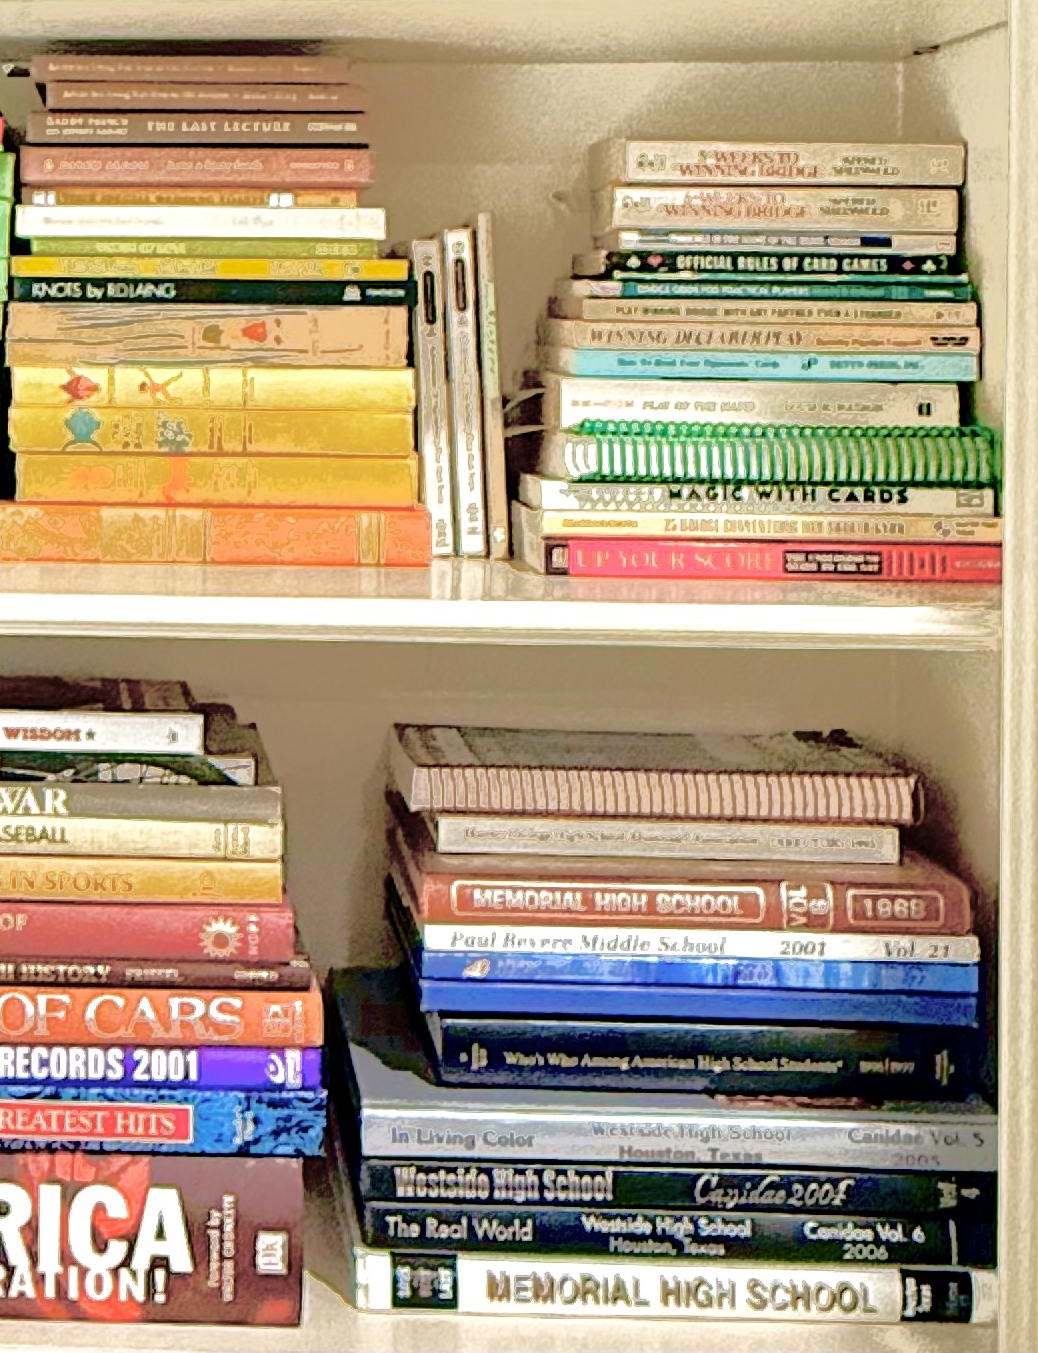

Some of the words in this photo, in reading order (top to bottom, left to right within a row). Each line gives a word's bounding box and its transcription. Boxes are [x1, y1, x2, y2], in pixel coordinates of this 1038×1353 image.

[829, 490, 908, 503] CARDS
[4, 727, 80, 742] WISDOM
[10, 872, 37, 889] IN
[45, 873, 133, 892] SPORTS
[474, 889, 585, 911] MEMORIAL
[595, 891, 647, 912] HIGH
[655, 893, 745, 914] SCHOOL
[659, 935, 726, 954] School
[85, 997, 243, 1040] CARS
[133, 1049, 198, 1081] 2001
[114, 1112, 174, 1136] HITS
[391, 1128, 412, 1144] In
[417, 1128, 475, 1149] Living
[483, 1130, 534, 1148] Color
[386, 1218, 419, 1238] The
[425, 1218, 467, 1239] Real
[474, 1219, 532, 1241] World
[487, 1271, 650, 1306] MEMORIAL
[660, 1277, 736, 1308] HIGH
[747, 1282, 879, 1314] SCHOOL
